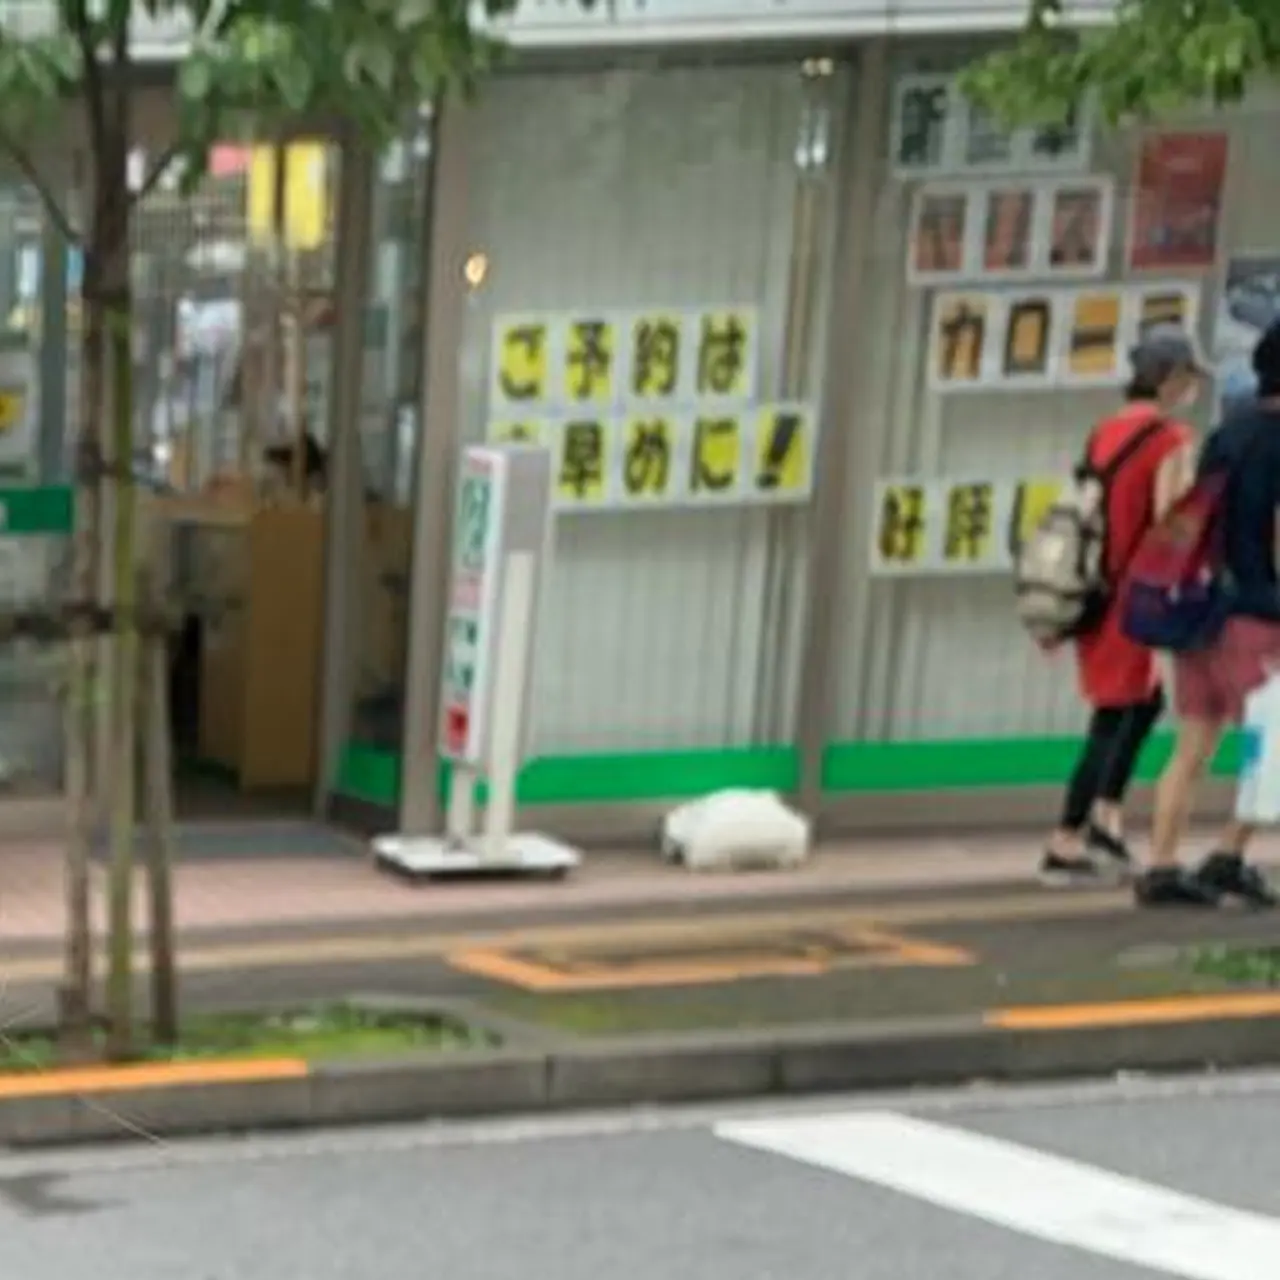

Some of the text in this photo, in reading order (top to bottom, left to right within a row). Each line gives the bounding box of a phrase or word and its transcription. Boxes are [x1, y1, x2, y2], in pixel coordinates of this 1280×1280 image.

[498, 312, 747, 402] ご予約は
[500, 411, 802, 497] 早めに!
